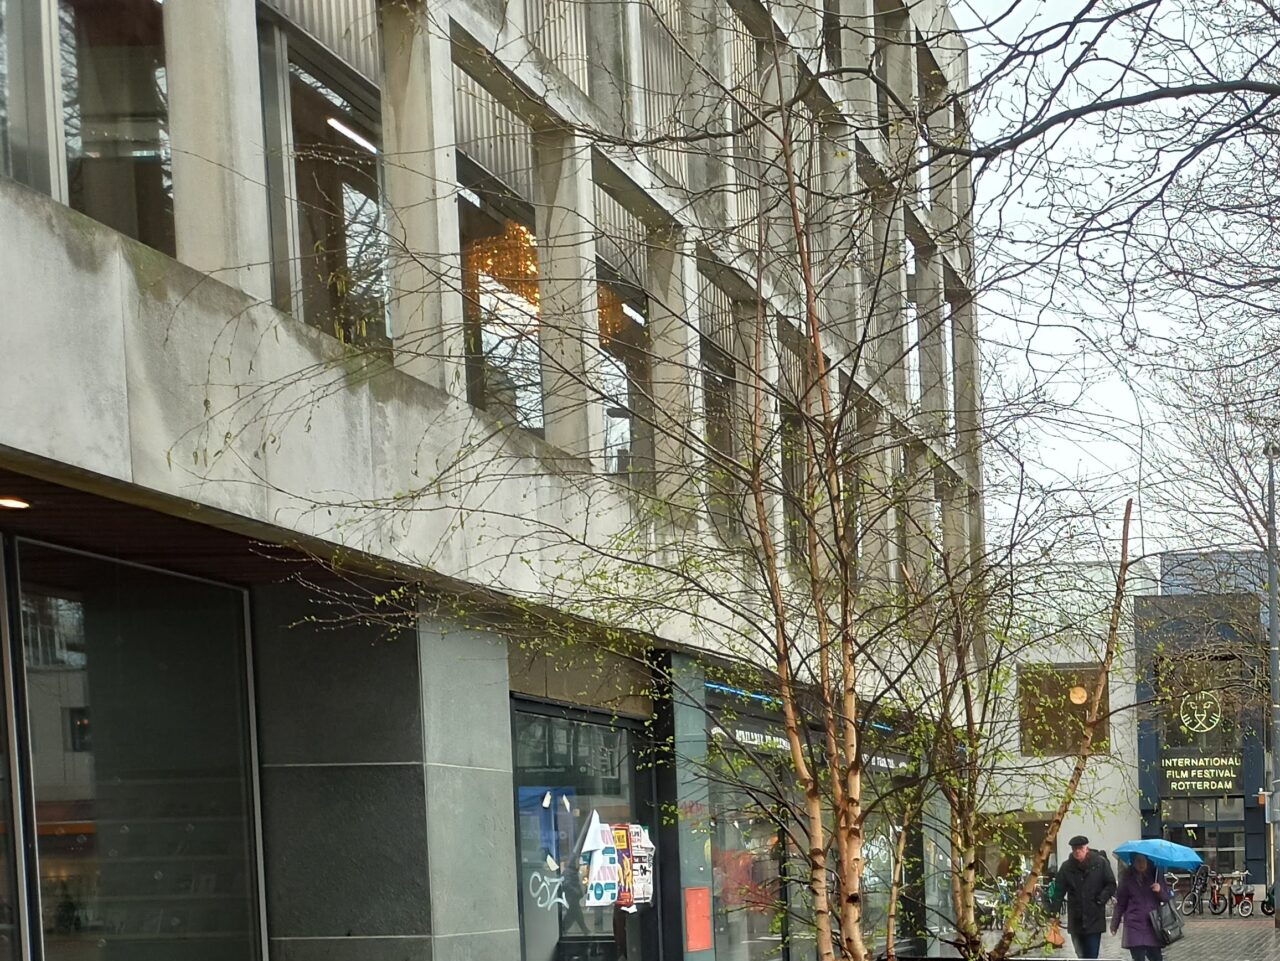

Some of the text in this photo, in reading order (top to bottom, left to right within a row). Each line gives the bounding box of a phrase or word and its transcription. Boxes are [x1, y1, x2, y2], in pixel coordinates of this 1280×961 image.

[1162, 757, 1241, 767] INTERNATIONAL
[1166, 768, 1237, 778] FILM FESTIVAL
[1170, 780, 1233, 790] ROTTERDAM
